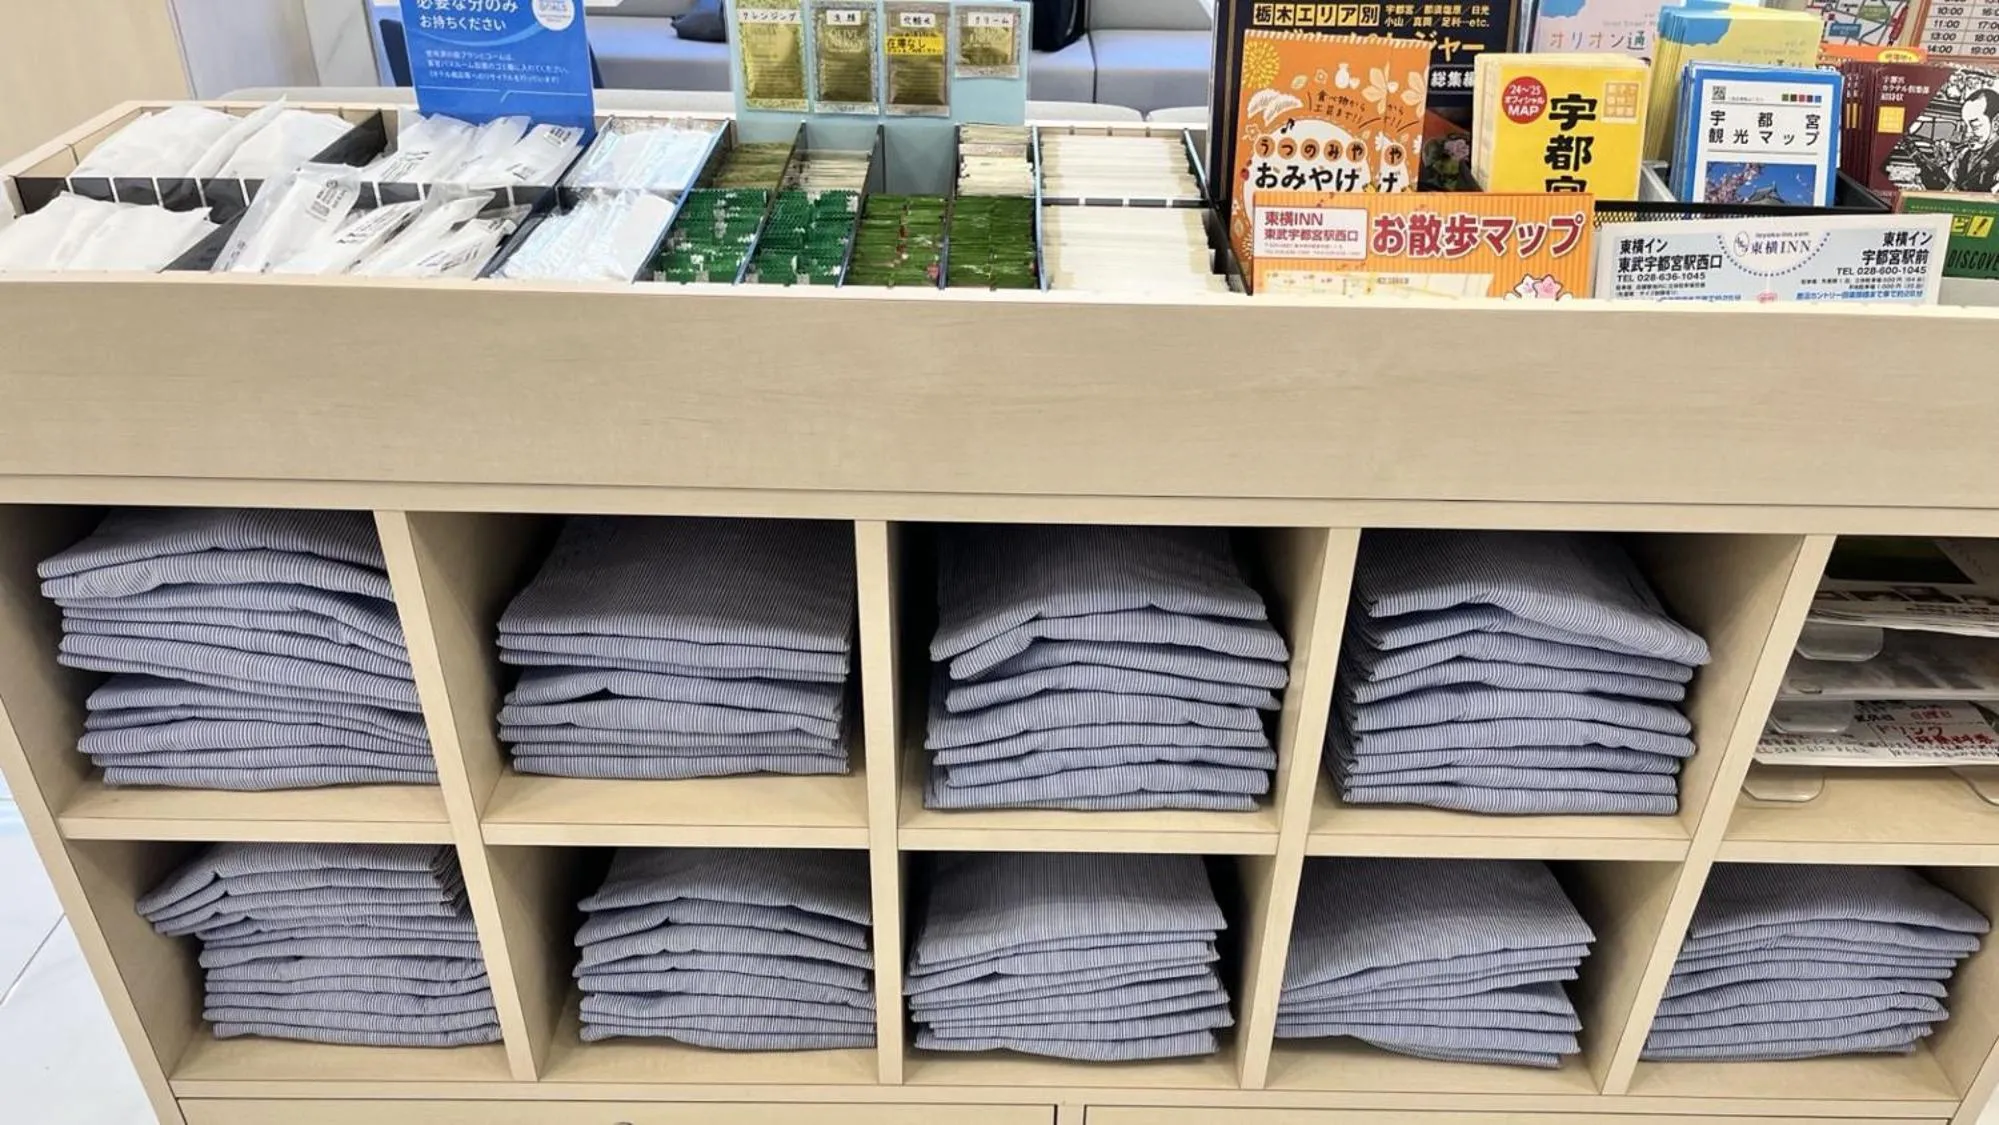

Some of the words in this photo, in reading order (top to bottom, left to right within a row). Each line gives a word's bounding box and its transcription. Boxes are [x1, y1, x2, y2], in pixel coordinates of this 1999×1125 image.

[416, 0, 519, 13] 必要な分のみ
[1937, 6, 1964, 16] 10:00
[1982, 7, 1999, 16] 16:0
[1255, 4, 1379, 26] 栃木エリア別
[419, 15, 507, 31] お持ちください
[1933, 20, 1960, 29] 11:00
[1978, 20, 1999, 29] 17:0
[886, 37, 926, 49] 在庫なし
[1550, 30, 1656, 50] オリオン通
[1930, 32, 1957, 41] 13:00
[1927, 45, 1953, 54] 14:00
[1971, 46, 1997, 55] 19:00
[1508, 105, 1540, 116] MAP
[1708, 127, 1820, 146] 観光マップ
[1258, 138, 1365, 162] うつのみや
[1264, 211, 1323, 226] 東横INN
[1264, 228, 1359, 242] 東武宇都宮駅西口
[1372, 213, 1586, 259] お散歩マップ
[1882, 231, 1933, 247] 東横イン
[1619, 238, 1669, 255] 東横イン
[1617, 254, 1723, 273] 東武宇都宮駅西口
[1862, 248, 1930, 266] 宇都宮駅前
[1617, 274, 1635, 282] TEL
[1637, 272, 1706, 281] 028-636-1045
[1837, 267, 1854, 275] TEL
[1857, 266, 1927, 275] 028-600-1045
